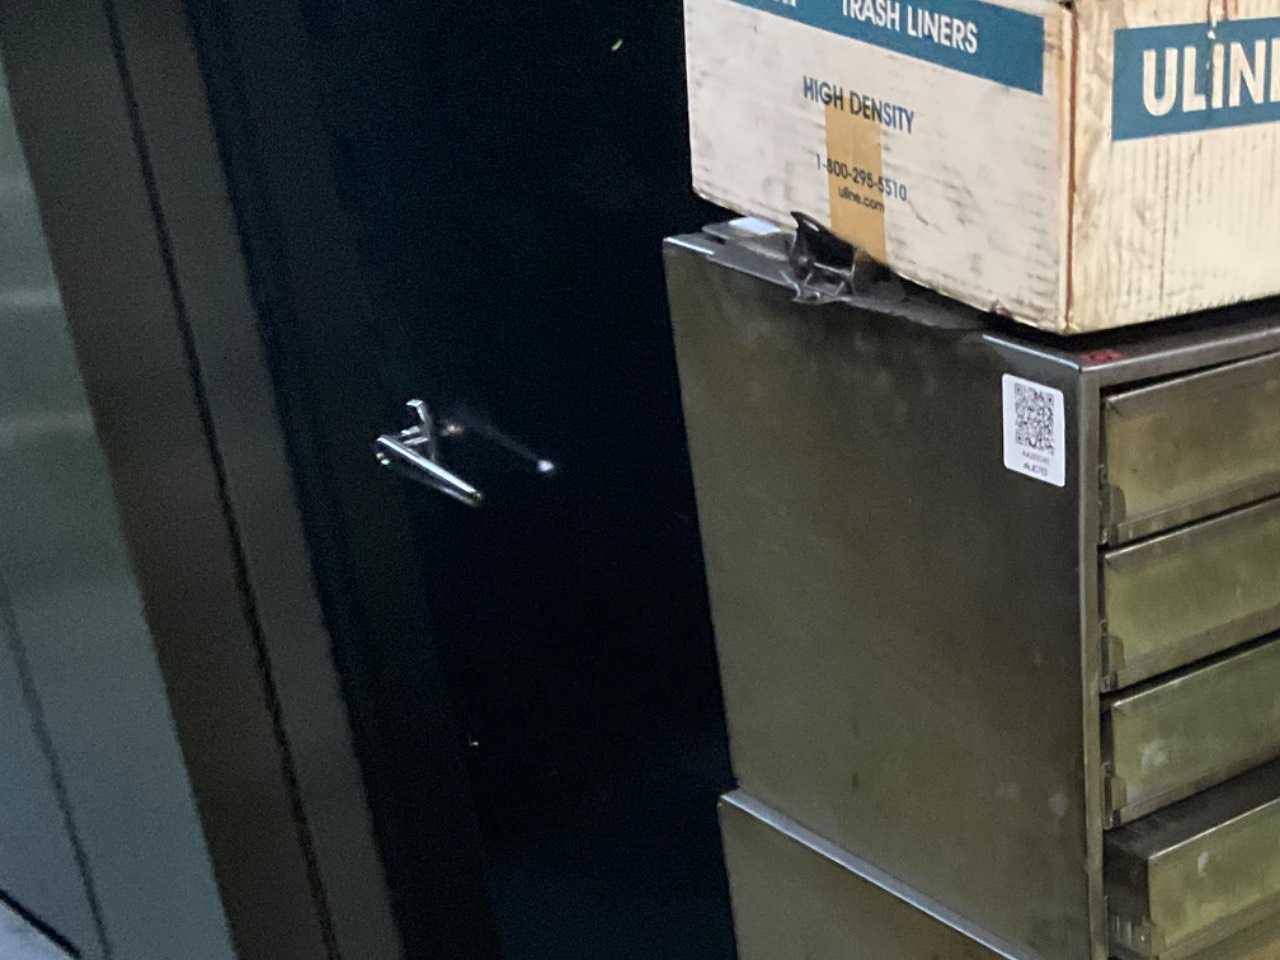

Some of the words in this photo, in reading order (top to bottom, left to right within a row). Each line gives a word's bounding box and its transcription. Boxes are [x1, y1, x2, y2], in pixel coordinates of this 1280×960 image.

[842, 0, 900, 31] TRASH
[906, 6, 977, 54] LINERS
[803, 76, 844, 111] HIGH
[850, 91, 914, 134] DENSITY
[816, 153, 907, 201] 1-800-295-5510
